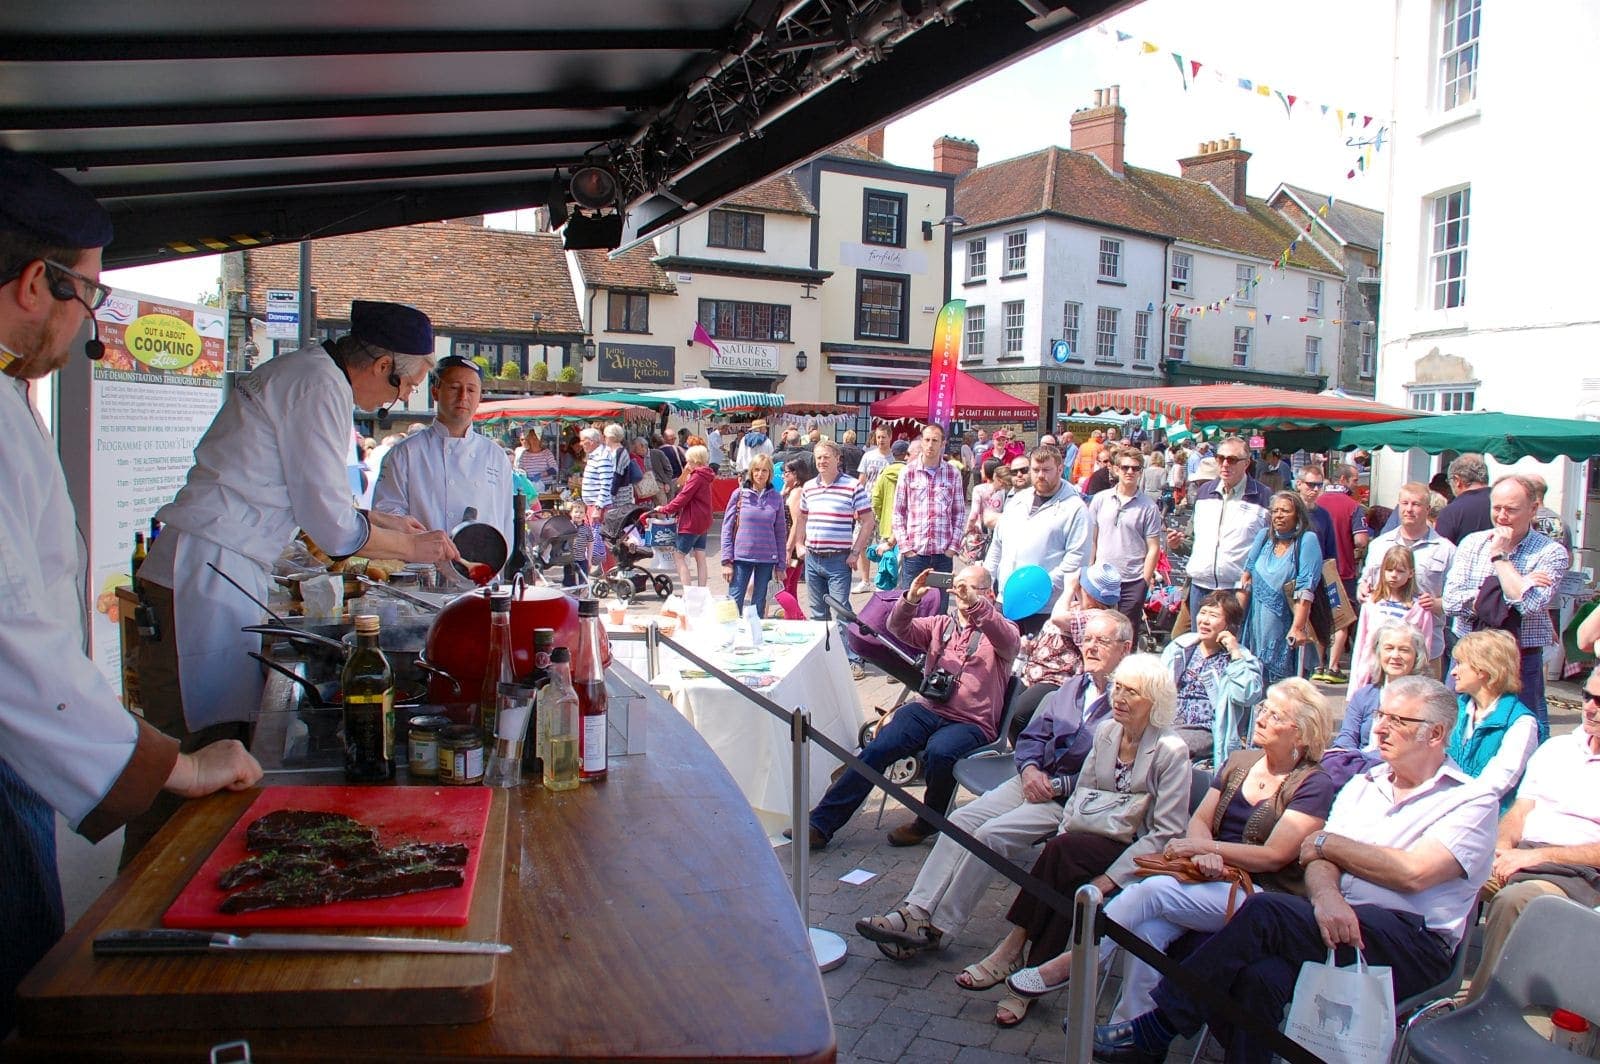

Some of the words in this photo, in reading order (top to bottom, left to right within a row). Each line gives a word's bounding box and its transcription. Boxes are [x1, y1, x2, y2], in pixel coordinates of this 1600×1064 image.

[144, 327, 157, 336] OUT
[165, 330, 186, 340] ABOUT
[134, 337, 194, 357] COOKING
[721, 343, 768, 358] NATURE'S
[716, 355, 772, 368] TREASURES
[95, 370, 108, 379] LIVE
[109, 371, 163, 383] DEMONSTRATIONS
[163, 375, 201, 386] THROUGHOUT
[965, 409, 981, 417] CRAFT
[998, 409, 1012, 417] FROM
[1013, 409, 1031, 417] DORSET
[97, 439, 141, 452] PROGRAMME
[144, 441, 153, 450] OF
